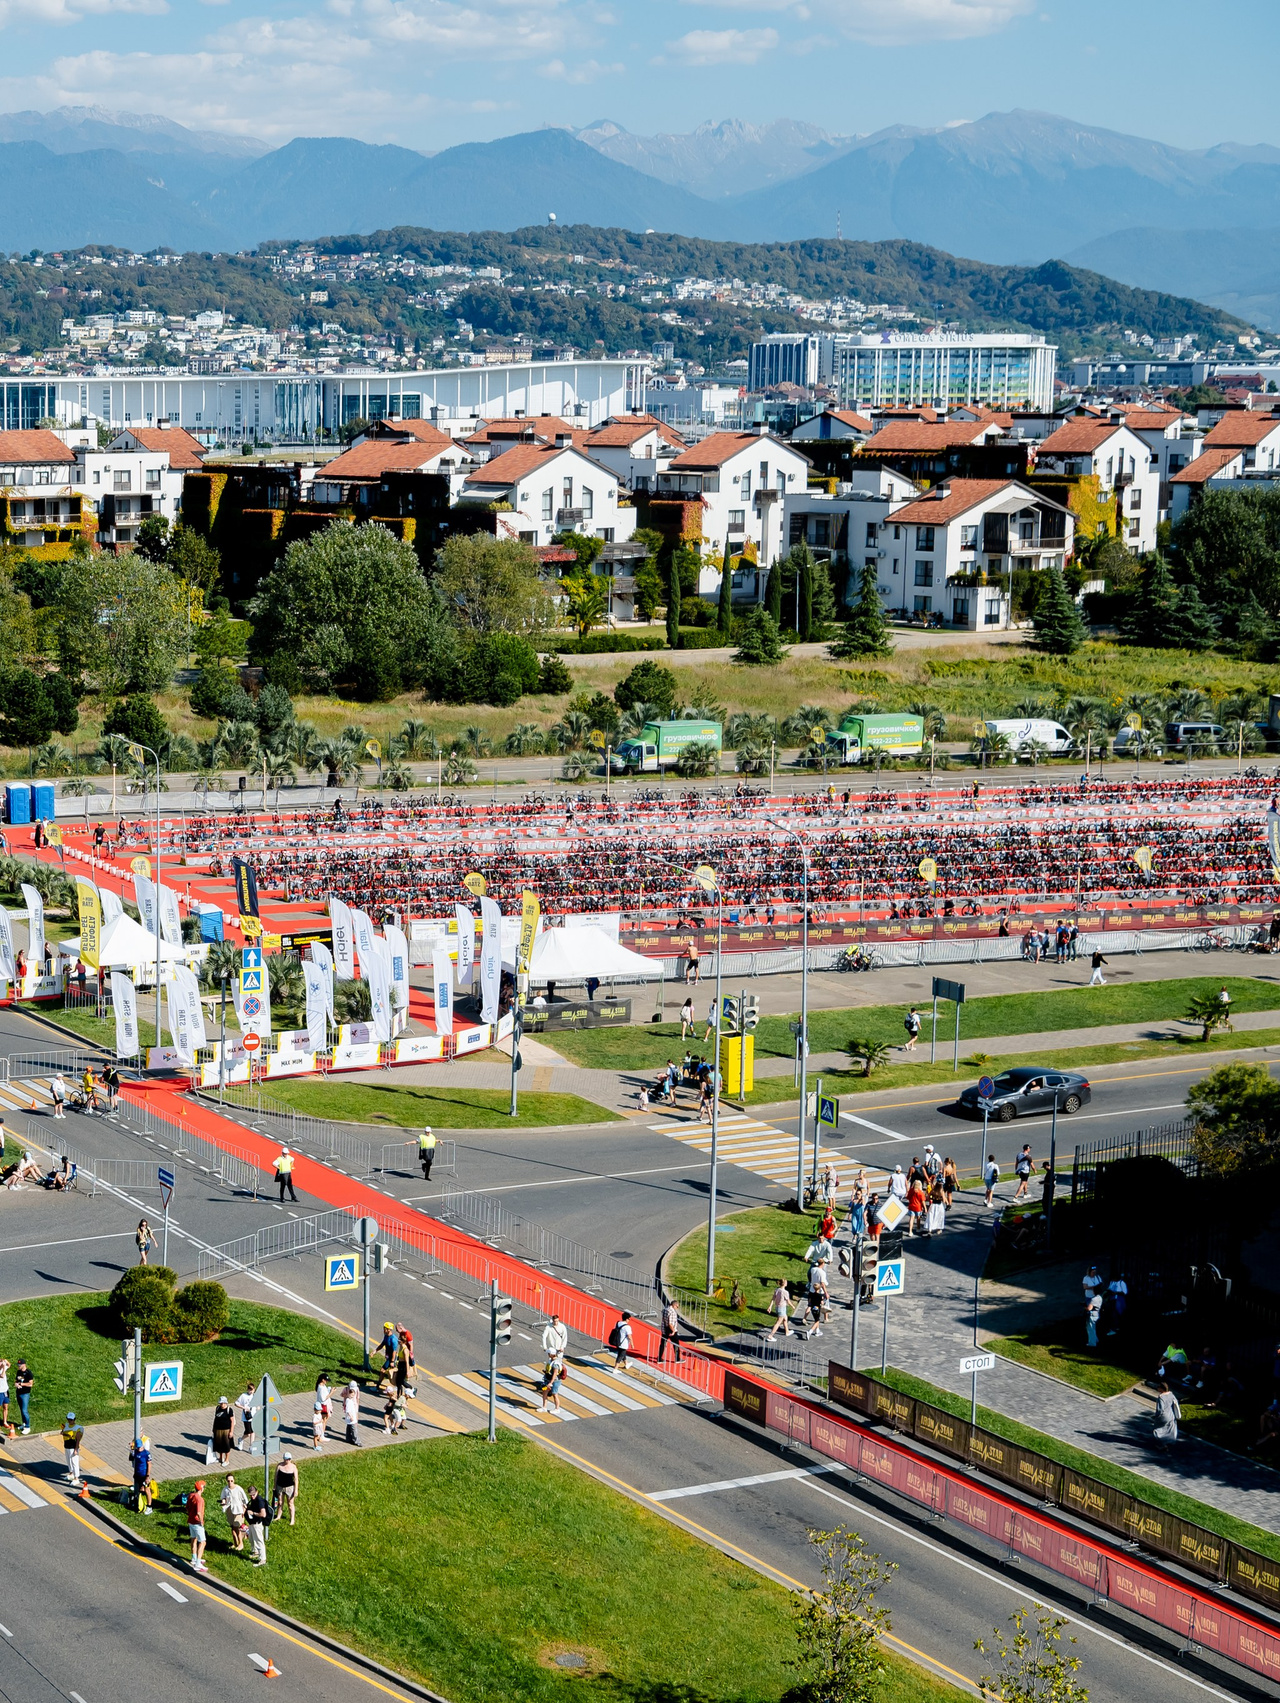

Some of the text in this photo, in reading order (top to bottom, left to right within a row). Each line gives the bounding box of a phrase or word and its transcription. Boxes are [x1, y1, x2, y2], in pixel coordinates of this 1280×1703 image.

[894, 331, 974, 343] OMEGA SIRIUS
[110, 364, 188, 374] Университет Сириус
[664, 734, 718, 743] грузовичкоф
[867, 726, 920, 735] грузовичкоф
[46, 980, 56, 988] STAR
[615, 1006, 626, 1014] STAR
[964, 1356, 990, 1370] СТОП
[834, 1376, 864, 1396] IRON STAR
[732, 1386, 760, 1408] IRON STAR
[878, 1396, 908, 1416] IRON STAR
[920, 1414, 954, 1436] IRON STAR
[970, 1437, 1004, 1459] IRON STAR
[1020, 1460, 1054, 1483] IRON STAR
[1069, 1482, 1106, 1508] IRON STAR
[1124, 1508, 1162, 1535] IRON STAR
[1182, 1534, 1220, 1560] IRON STAR
[1238, 1560, 1280, 1587] IRON STAR
